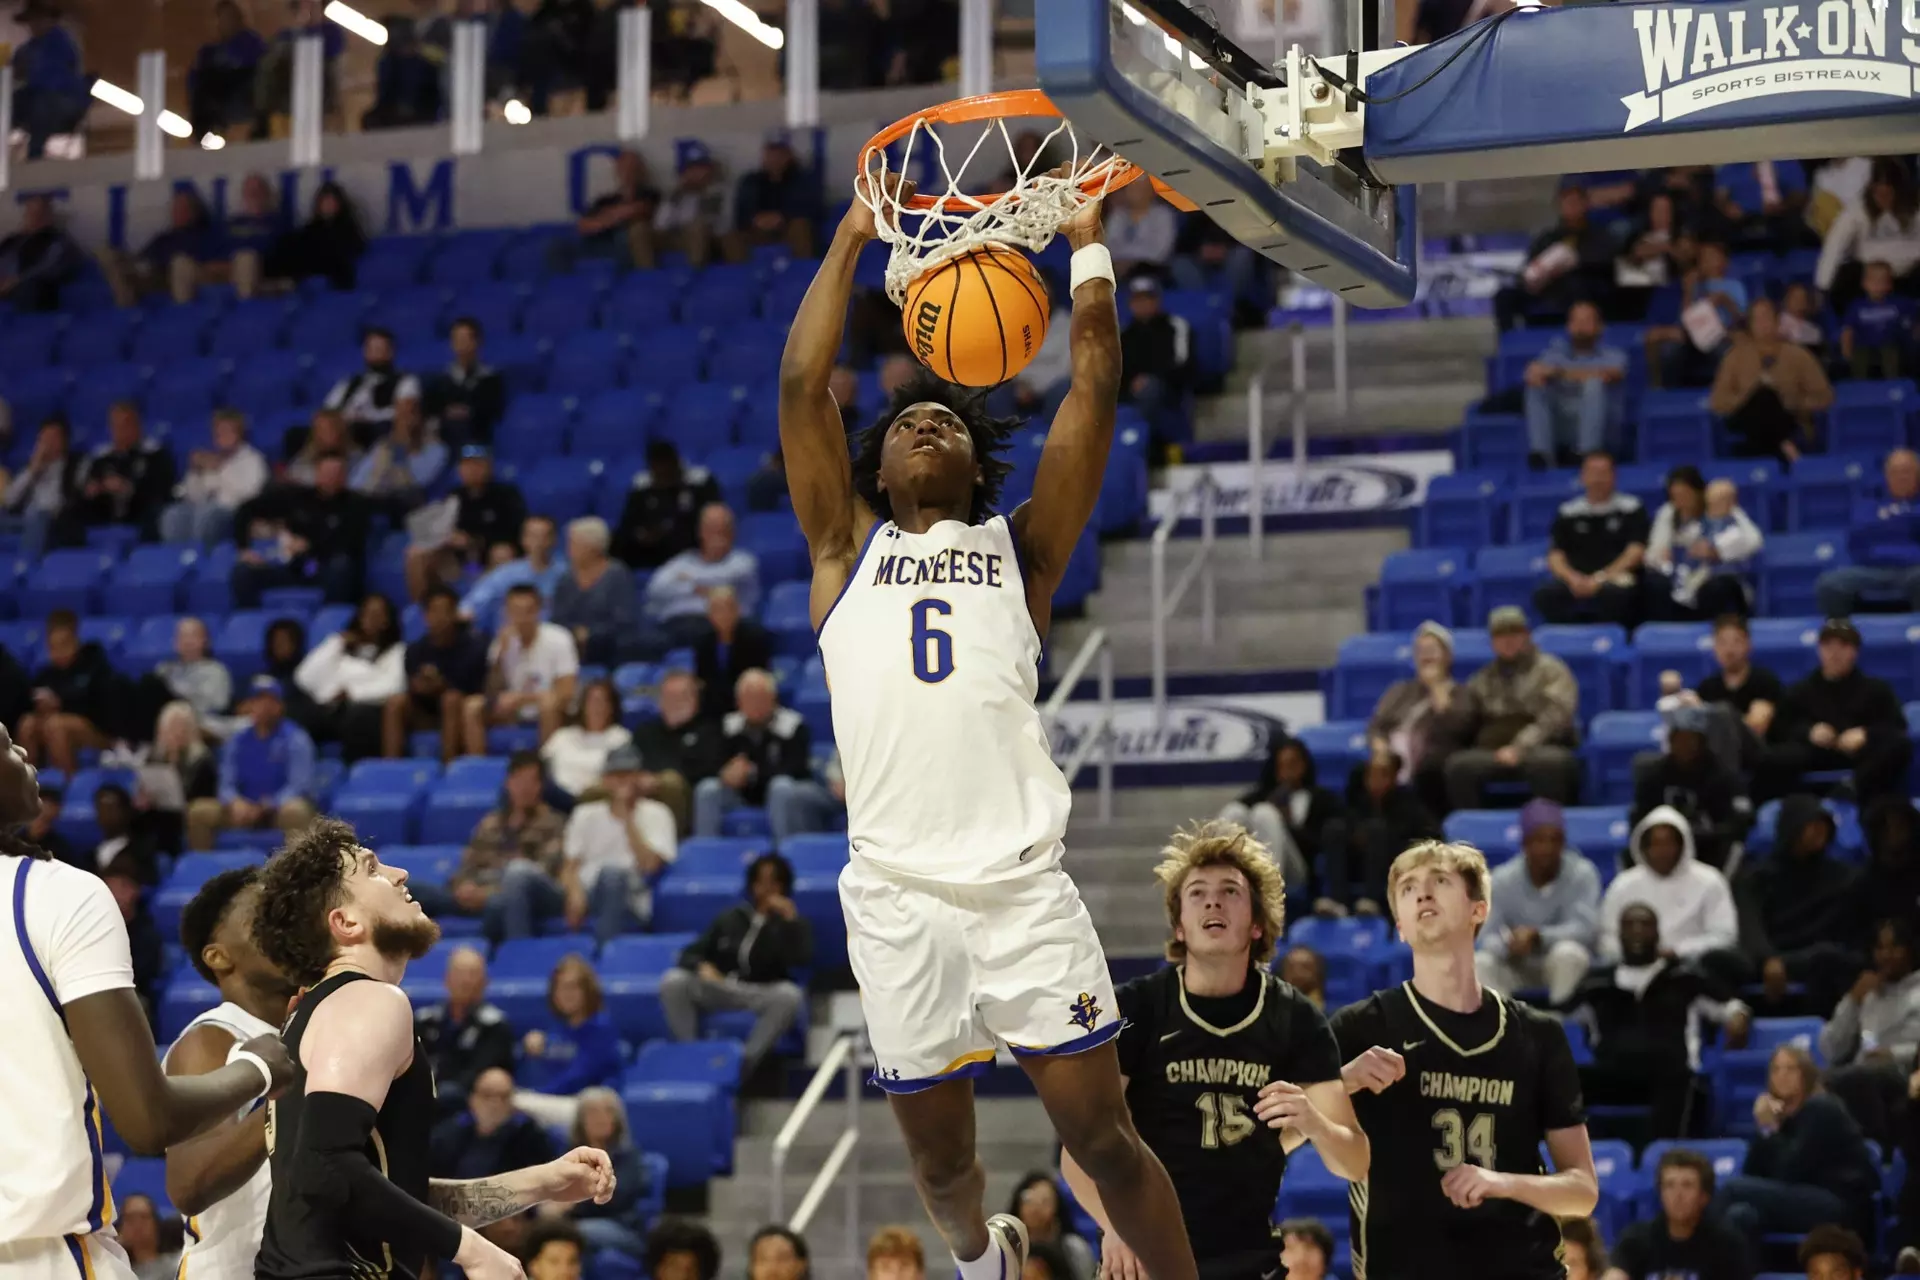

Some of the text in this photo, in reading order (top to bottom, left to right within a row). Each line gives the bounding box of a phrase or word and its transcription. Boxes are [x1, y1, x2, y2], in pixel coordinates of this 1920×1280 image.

[1692, 69, 1881, 100] SPORTS BISTREAUX
[872, 548, 1002, 588] MCNEESE
[910, 597, 957, 685] 6
[1166, 1058, 1271, 1088] CHAMPION
[1420, 1070, 1515, 1106] CHAMPION
[1195, 1092, 1256, 1149] 15
[1431, 1108, 1497, 1171] 34
